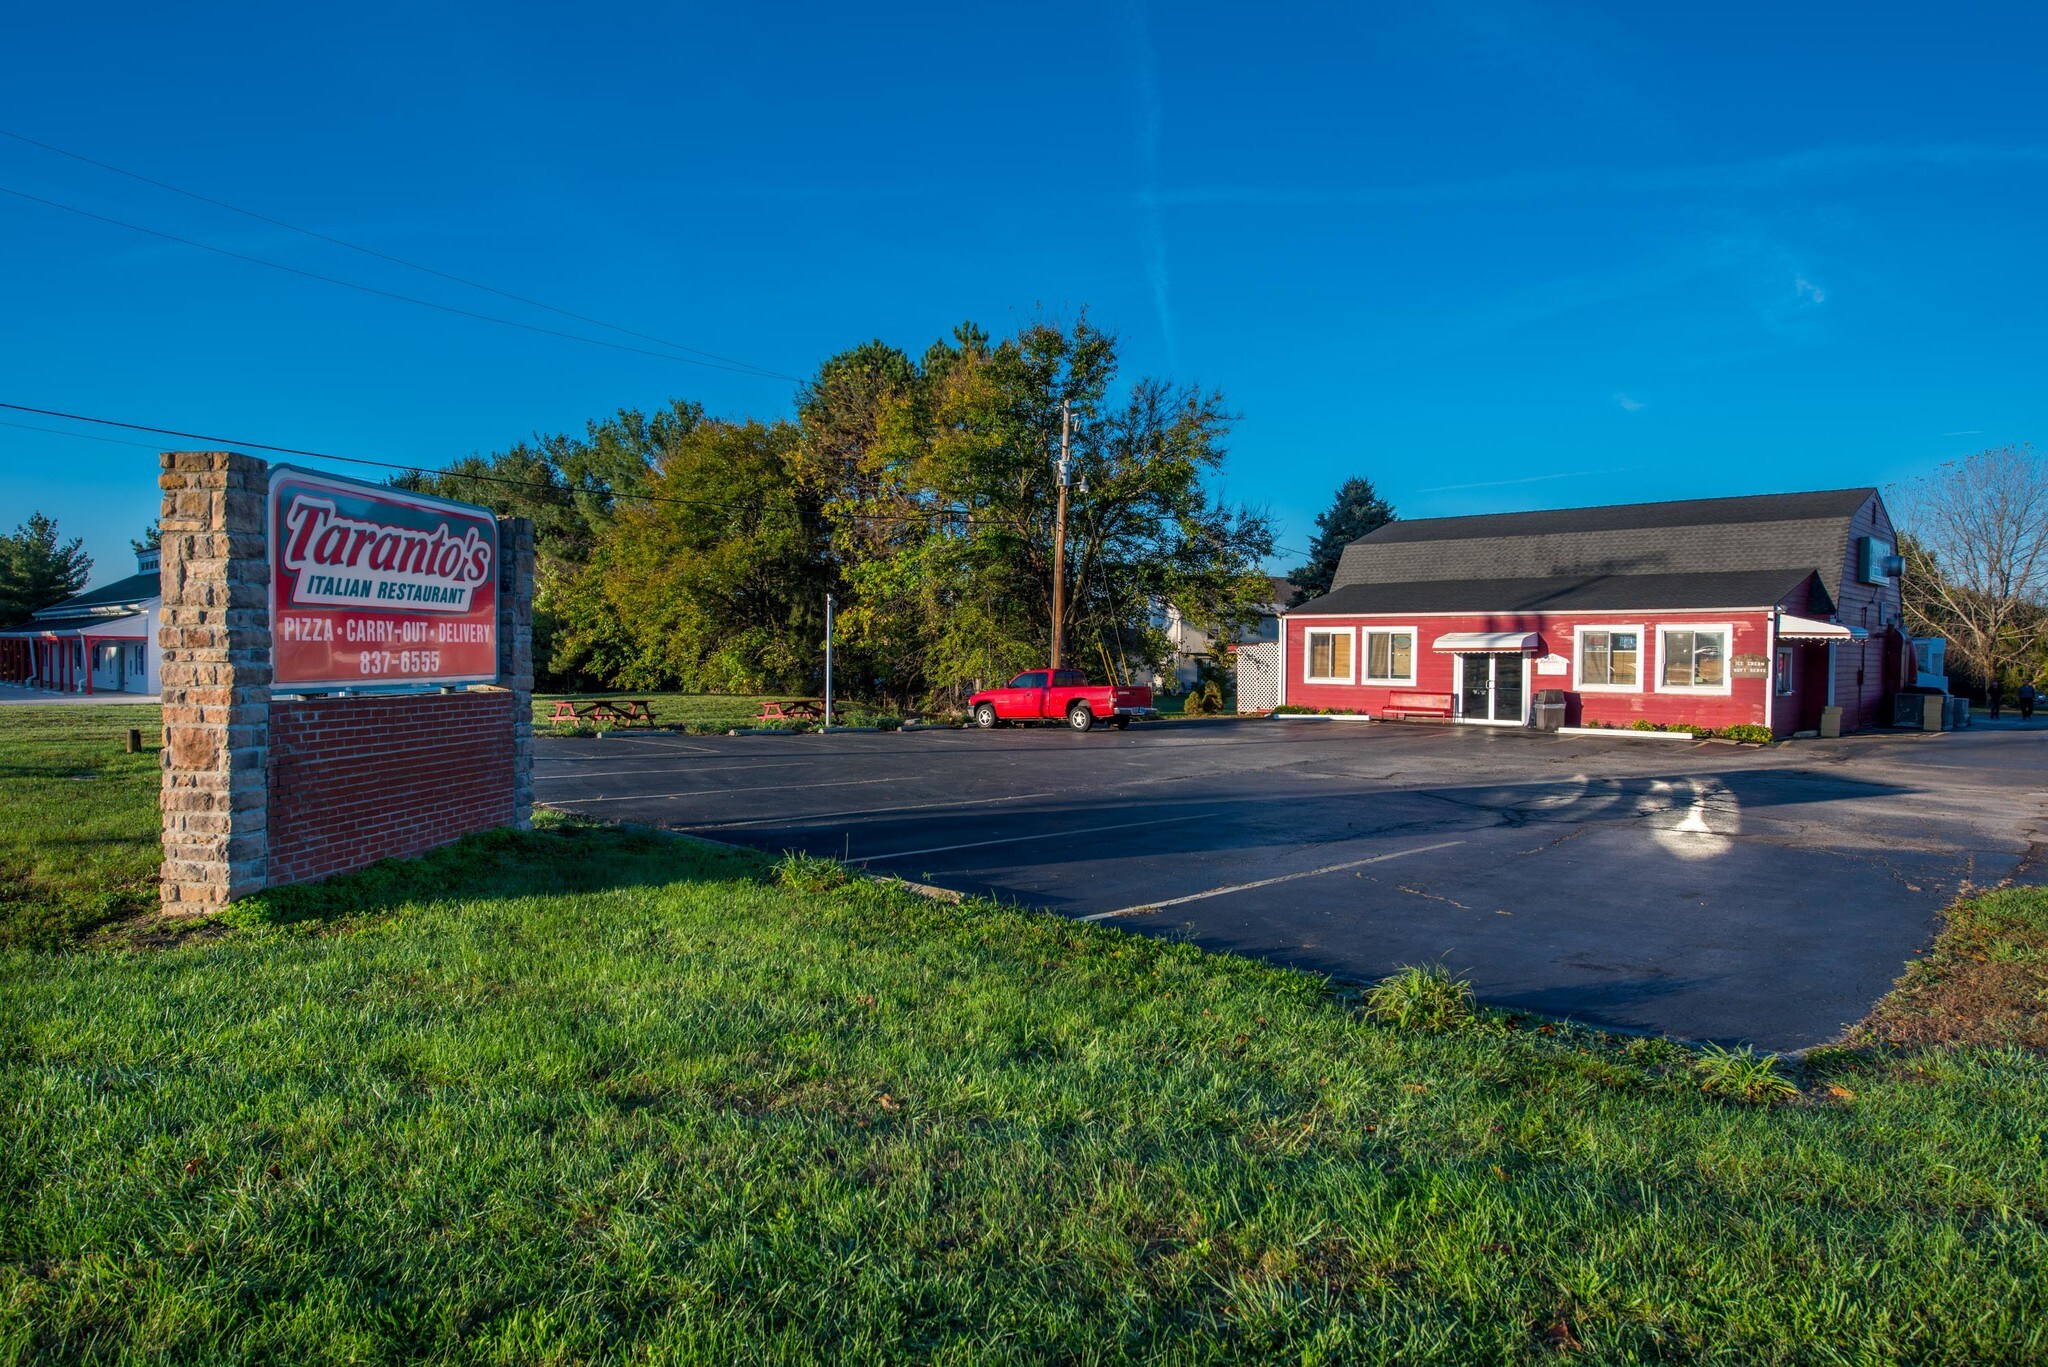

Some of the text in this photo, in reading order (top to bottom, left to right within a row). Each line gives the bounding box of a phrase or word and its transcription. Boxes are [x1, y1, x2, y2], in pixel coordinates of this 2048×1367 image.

[289, 503, 488, 583] Taranto's
[306, 574, 466, 605] ITALIAN RESTAURANT
[284, 617, 490, 643] PIZZA CARRY-OUT DELIVERY
[359, 650, 440, 675] 837-6555
